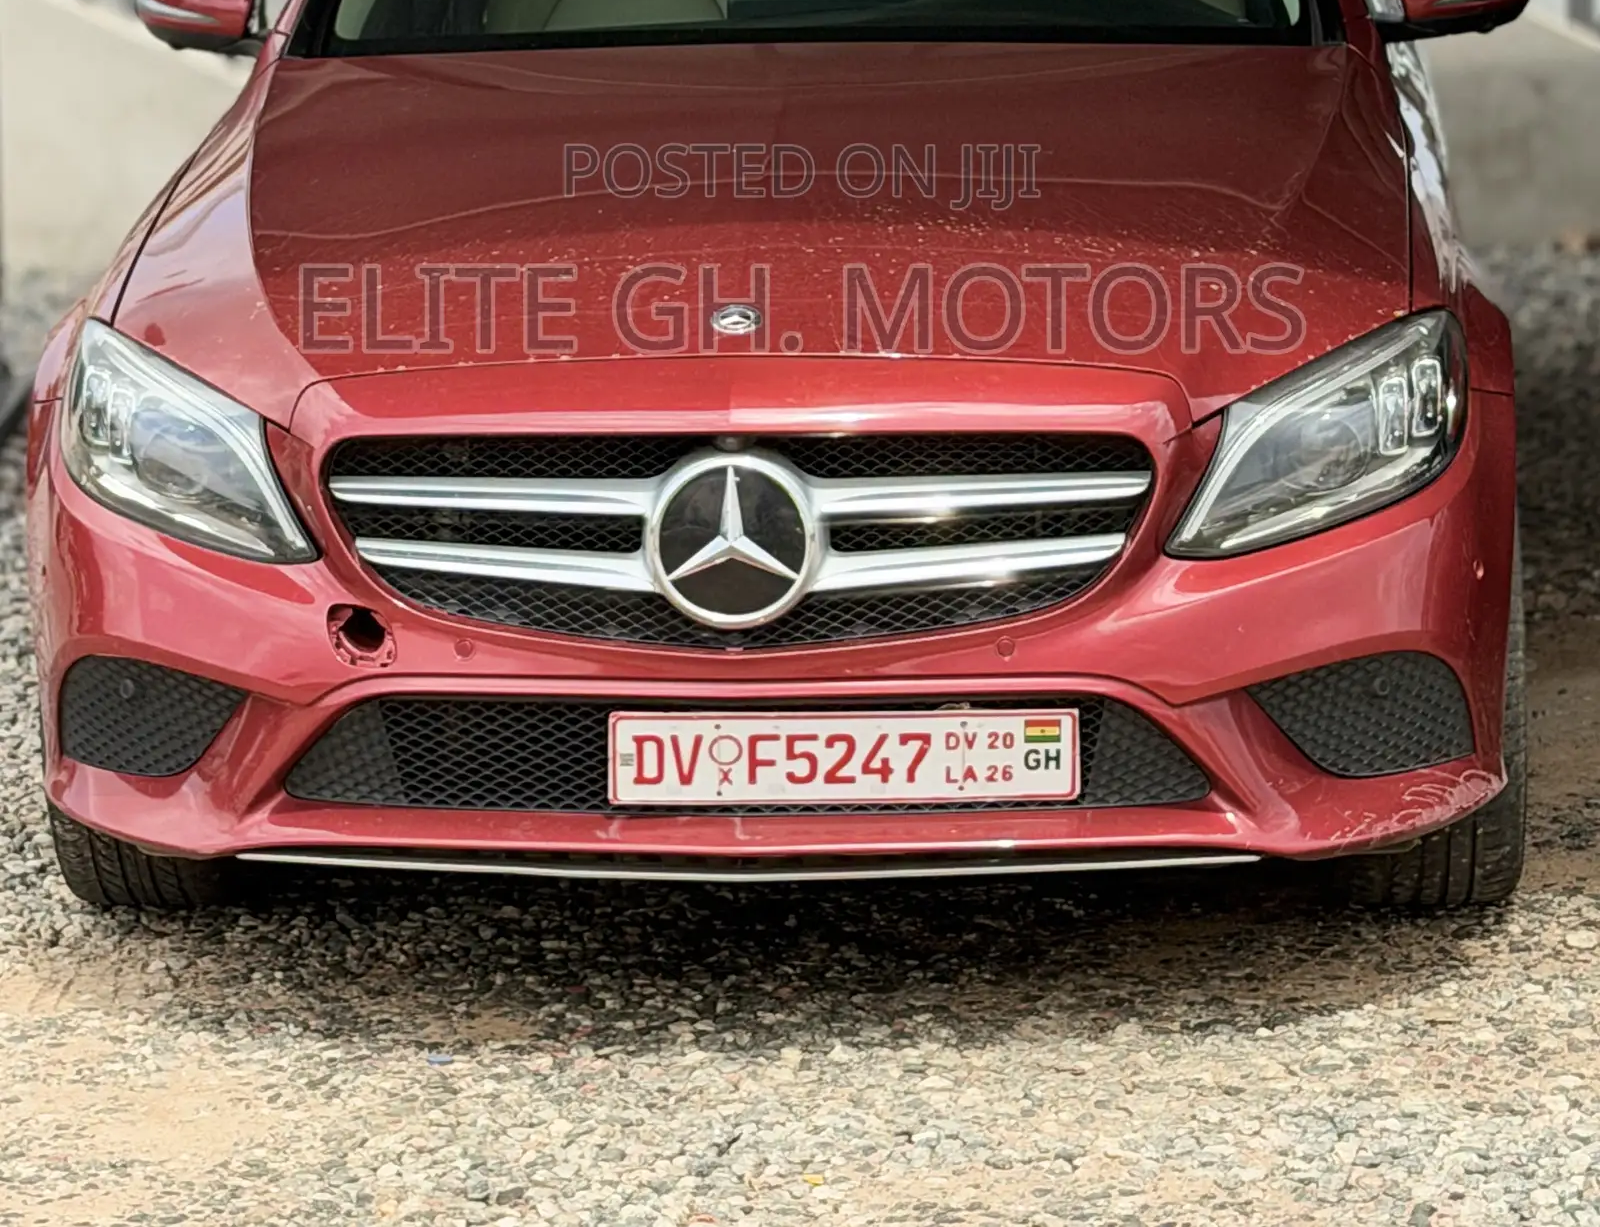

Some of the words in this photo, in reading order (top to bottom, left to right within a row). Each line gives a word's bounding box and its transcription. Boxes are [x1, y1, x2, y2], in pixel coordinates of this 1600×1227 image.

[945, 731, 977, 750] DV
[987, 731, 1015, 750] 20
[632, 734, 703, 785] DV
[747, 733, 932, 785] F5247
[1024, 748, 1061, 771] GH
[945, 764, 977, 783] LA
[985, 764, 1014, 782] 26
